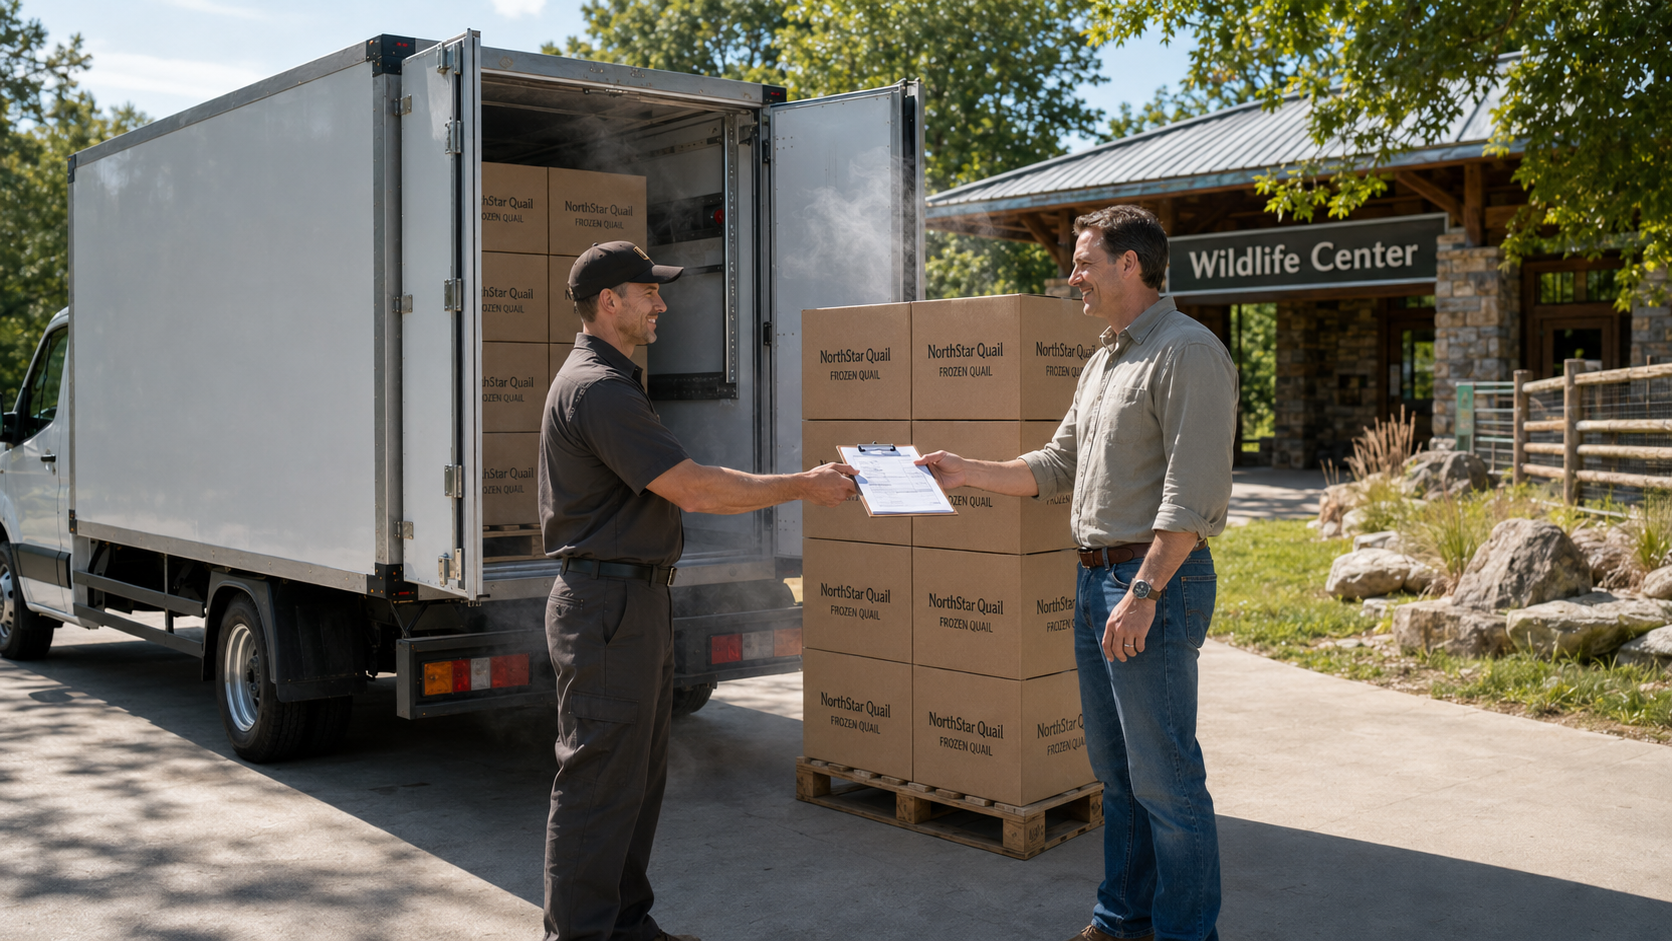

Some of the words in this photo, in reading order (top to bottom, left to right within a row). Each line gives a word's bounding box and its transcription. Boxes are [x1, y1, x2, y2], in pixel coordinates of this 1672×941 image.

[482, 195, 507, 207] hStar
[509, 197, 533, 210] Quail
[565, 200, 608, 214] NorthStar
[610, 204, 633, 217] Quail
[481, 212, 501, 221] OZEN
[575, 218, 602, 228] FROZEN
[1189, 244, 1300, 279] Wildlife
[1311, 241, 1418, 272] Center
[481, 286, 507, 298] hStar
[509, 287, 533, 300] Quail
[482, 303, 502, 313] OZEN
[820, 349, 864, 364] NorthStar
[866, 347, 891, 362] Quail
[928, 343, 975, 359] NorthStar
[977, 342, 1003, 359] Quail
[1036, 341, 1075, 358] NorthStar
[830, 370, 857, 381] FROZEN
[859, 369, 880, 381] QUAIL
[939, 366, 967, 377] FROZEN
[969, 365, 993, 377] QUAIL
[1046, 365, 1070, 377] FROZEN
[482, 376, 508, 388] hStar
[509, 376, 534, 390] Quail
[482, 393, 502, 403] OZEN
[482, 467, 508, 480] hStar
[509, 467, 534, 481] Quail
[482, 485, 502, 495] OZEN
[969, 496, 993, 508] QUAIL
[821, 582, 864, 600] NorthStar
[866, 587, 891, 604] Quail
[929, 593, 975, 612] NorthStar
[977, 598, 1004, 615] Quail
[830, 604, 858, 618] FROZEN
[859, 608, 881, 621] QUAIL
[939, 616, 968, 631] FROZEN
[969, 620, 993, 633] QUAIL
[1046, 619, 1071, 633] FROZEN
[821, 691, 864, 713] NorthStar
[866, 699, 891, 718] Quail
[830, 715, 858, 730] FROZEN
[859, 720, 881, 735] QUAIL
[929, 712, 976, 734] NorthStar
[977, 720, 1004, 739] Quail
[1037, 717, 1077, 739] NorthStar
[939, 736, 968, 751] FROZEN
[969, 742, 993, 757] QUAIL
[1047, 740, 1071, 756] FROZEN
